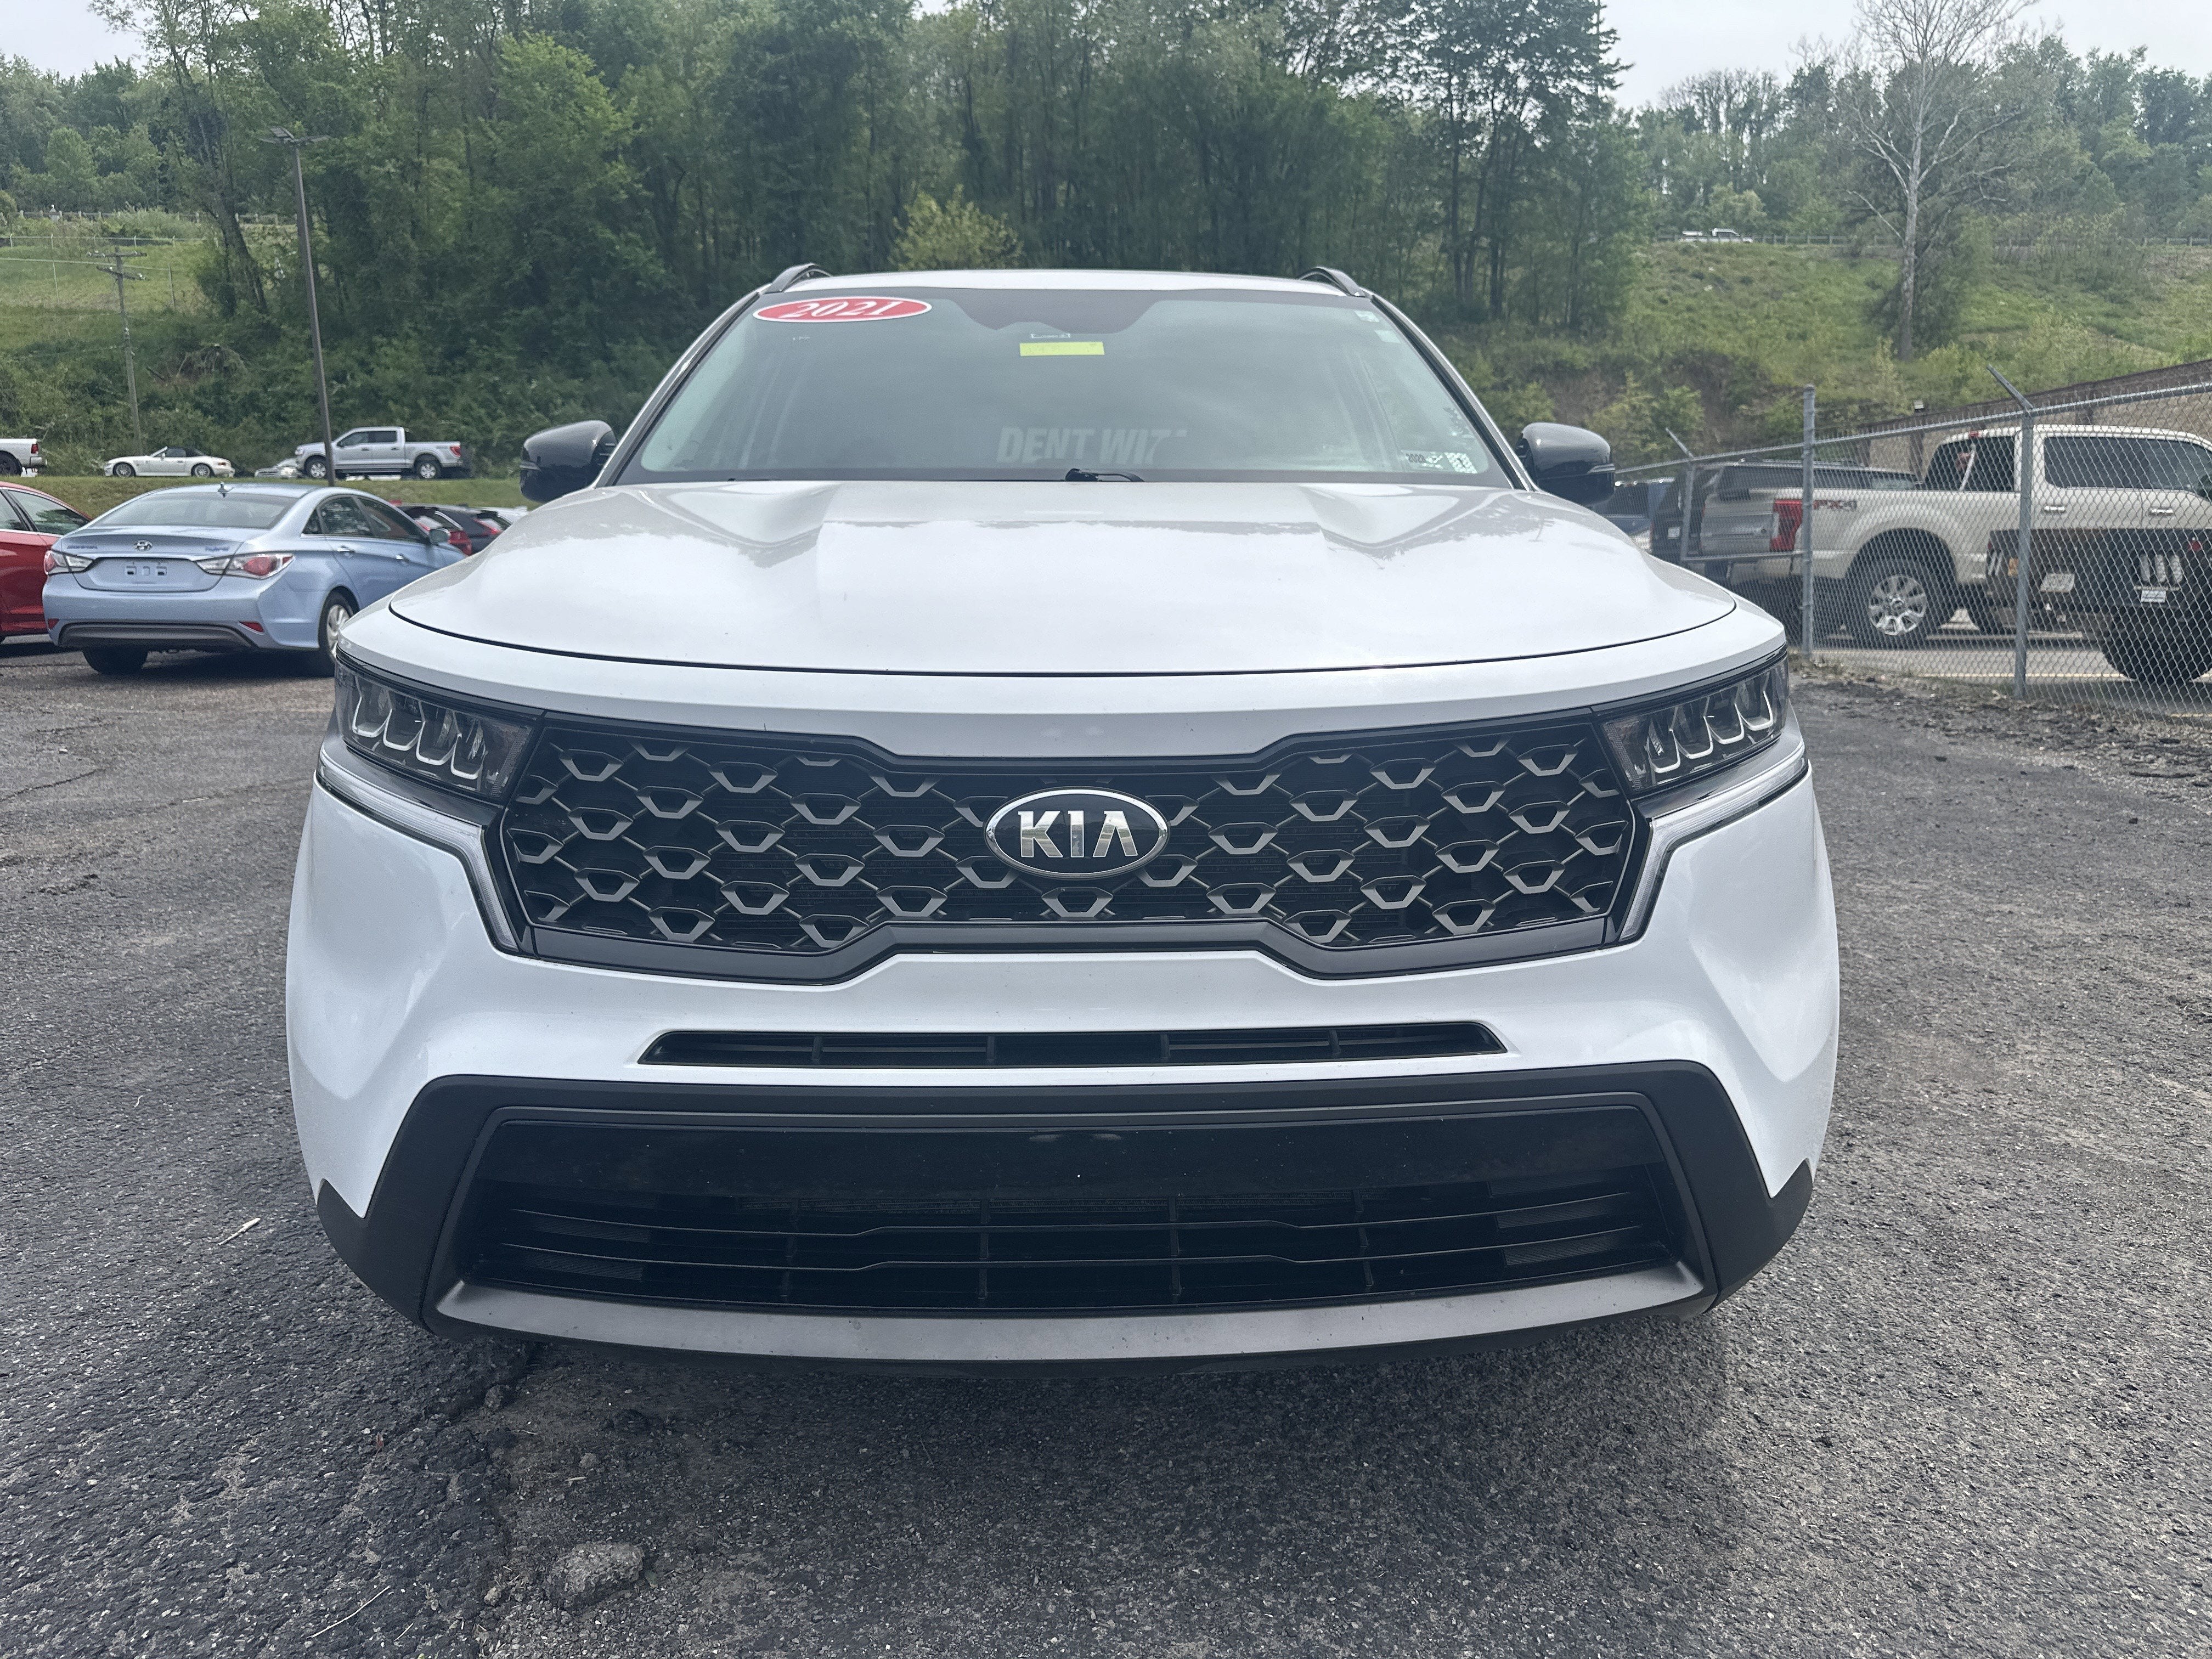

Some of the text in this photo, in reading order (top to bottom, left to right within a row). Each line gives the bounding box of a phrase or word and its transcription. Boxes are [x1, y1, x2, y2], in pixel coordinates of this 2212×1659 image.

[778, 301, 904, 318] 2021
[996, 427, 1095, 463] DENT
[1018, 810, 1138, 857] KIA
